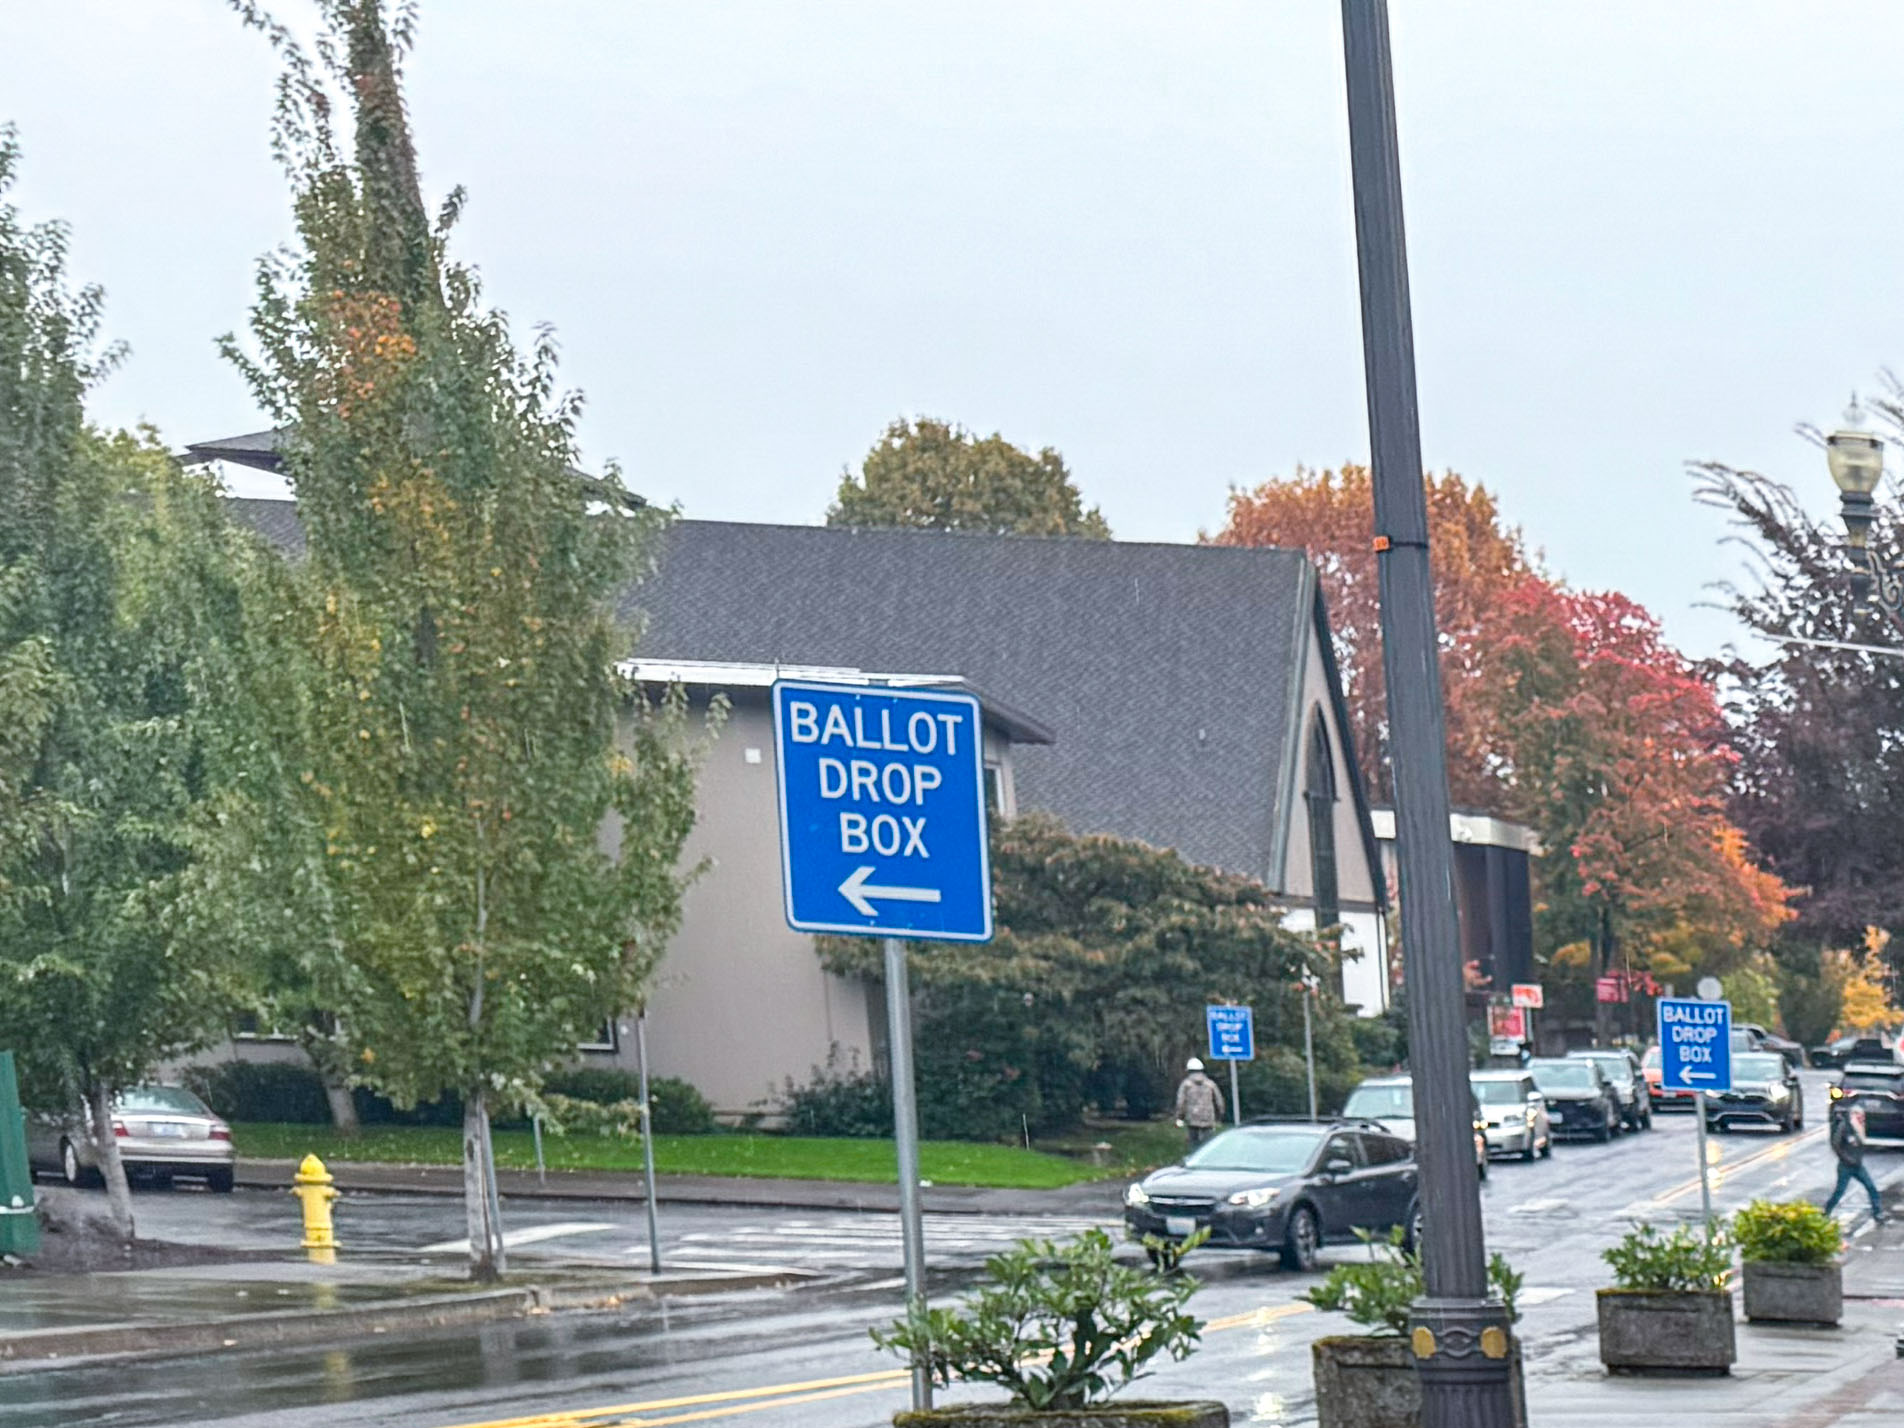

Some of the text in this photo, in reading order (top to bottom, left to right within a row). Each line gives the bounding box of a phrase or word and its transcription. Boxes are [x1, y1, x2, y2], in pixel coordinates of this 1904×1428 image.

[790, 702, 963, 755] BALLOT
[819, 758, 942, 805] DROP
[839, 812, 930, 858] BOX
[1663, 1006, 1724, 1025] BALLOT
[1672, 1026, 1717, 1043] DROP
[1679, 1045, 1712, 1063] BOX
